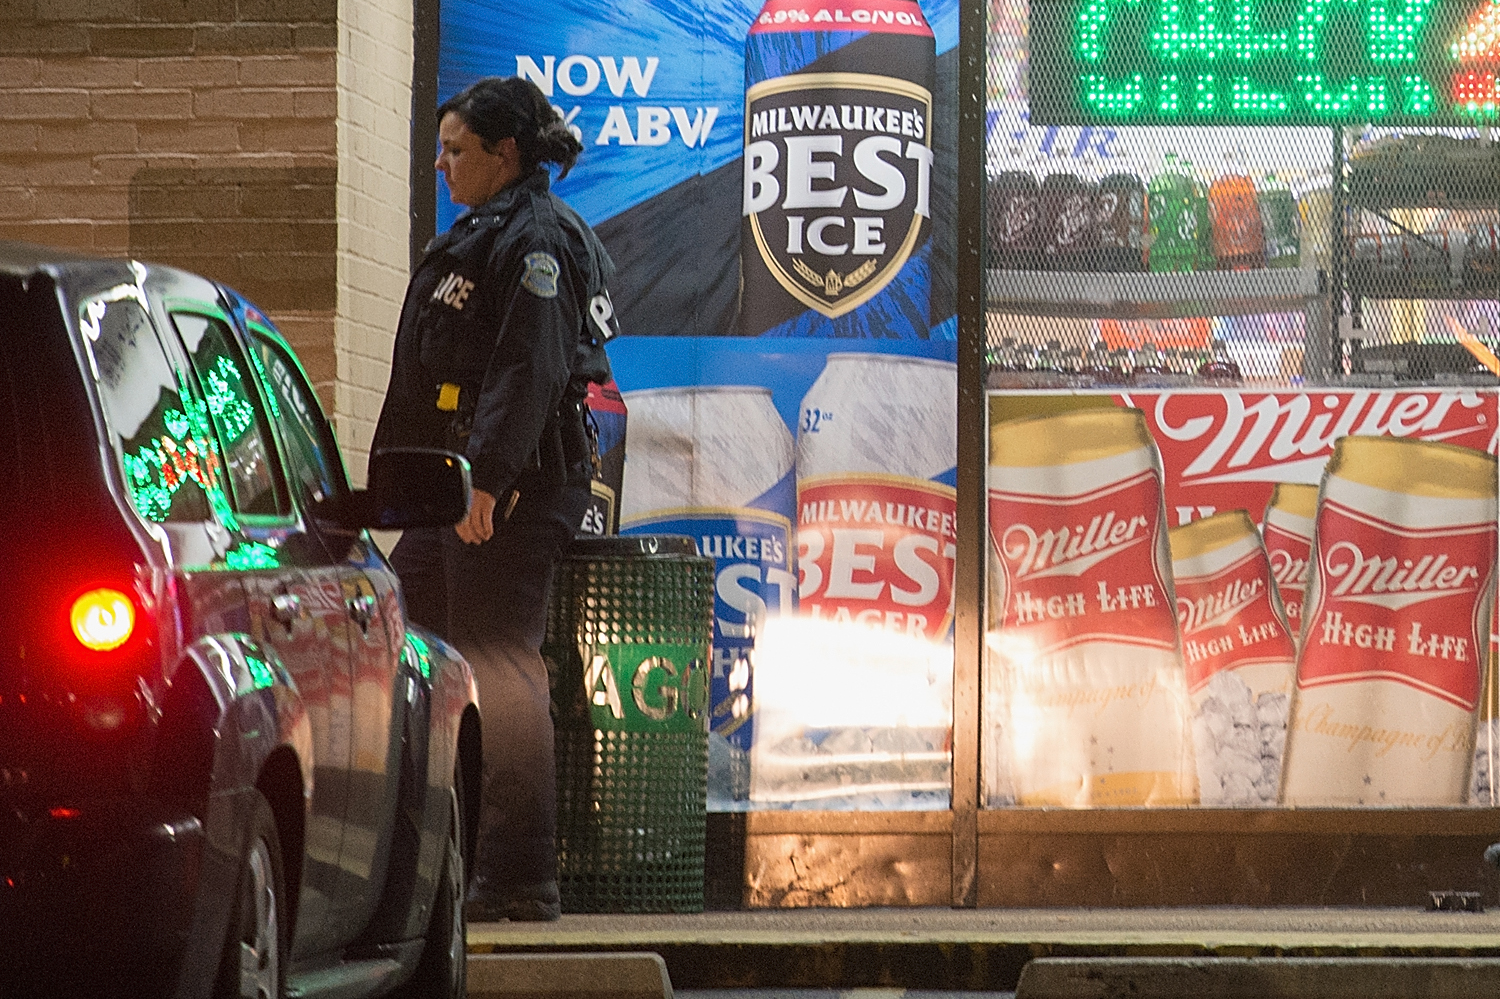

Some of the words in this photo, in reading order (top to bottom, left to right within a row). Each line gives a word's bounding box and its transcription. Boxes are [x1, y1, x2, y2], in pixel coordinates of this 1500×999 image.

[515, 55, 660, 98] NOW
[595, 106, 719, 149] ABV
[752, 105, 925, 140] MILWAUKEE'S
[743, 135, 935, 219] BEST
[785, 216, 887, 256] ICE
[434, 271, 476, 311] ICE
[802, 408, 821, 434] 32
[1155, 393, 1485, 478] Miller
[797, 528, 957, 607] BES
[1003, 510, 1150, 579] Miller
[1326, 541, 1480, 597] Miller
[1176, 577, 1264, 635] Miller
